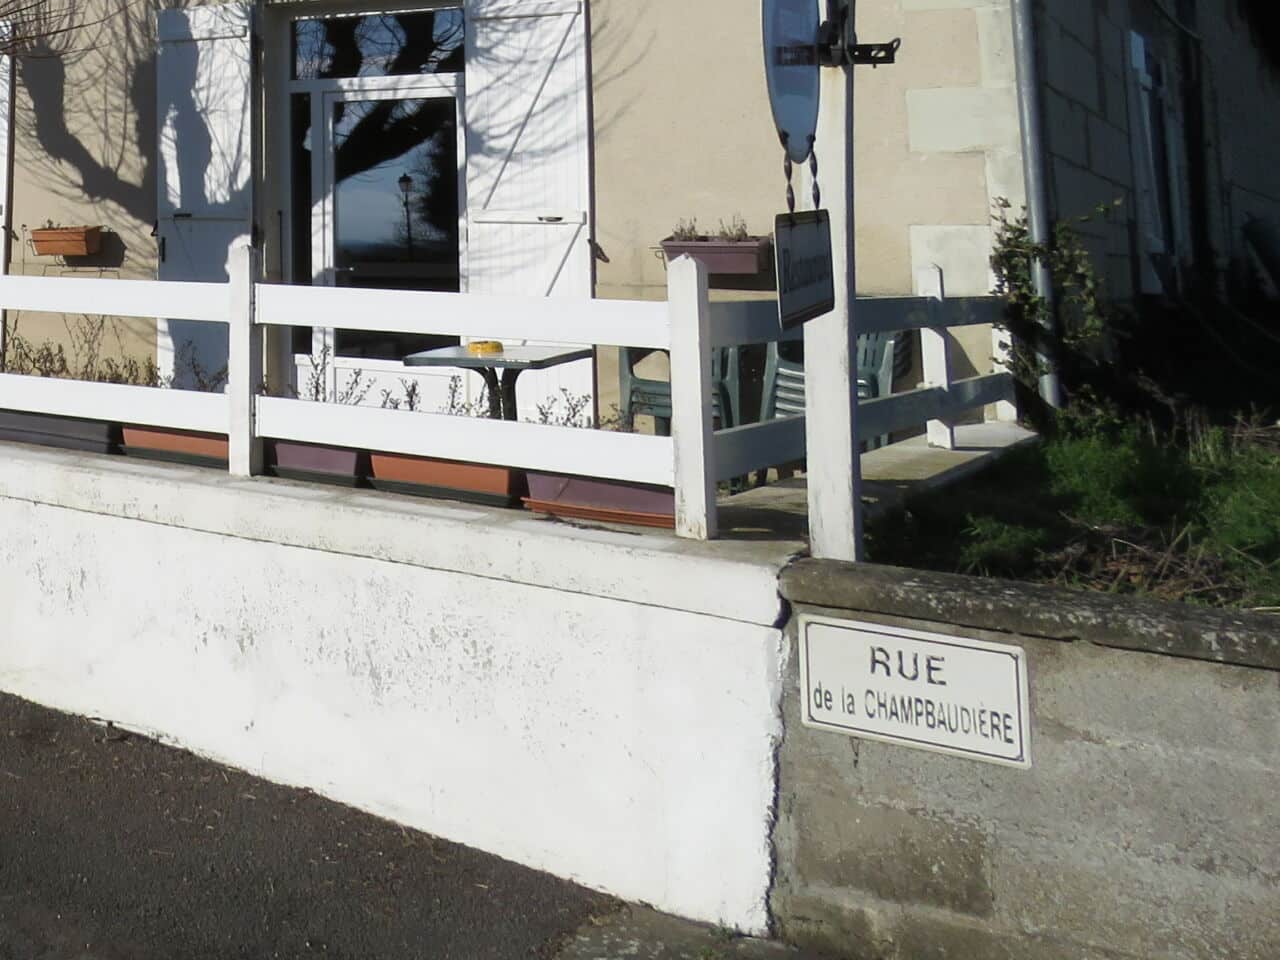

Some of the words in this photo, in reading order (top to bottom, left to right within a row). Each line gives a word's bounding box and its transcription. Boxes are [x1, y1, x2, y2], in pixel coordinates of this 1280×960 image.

[870, 646, 947, 685] RUE
[813, 681, 834, 711] de
[841, 686, 856, 716] la
[864, 688, 1015, 745] CHAMPBAUDIÈRE
